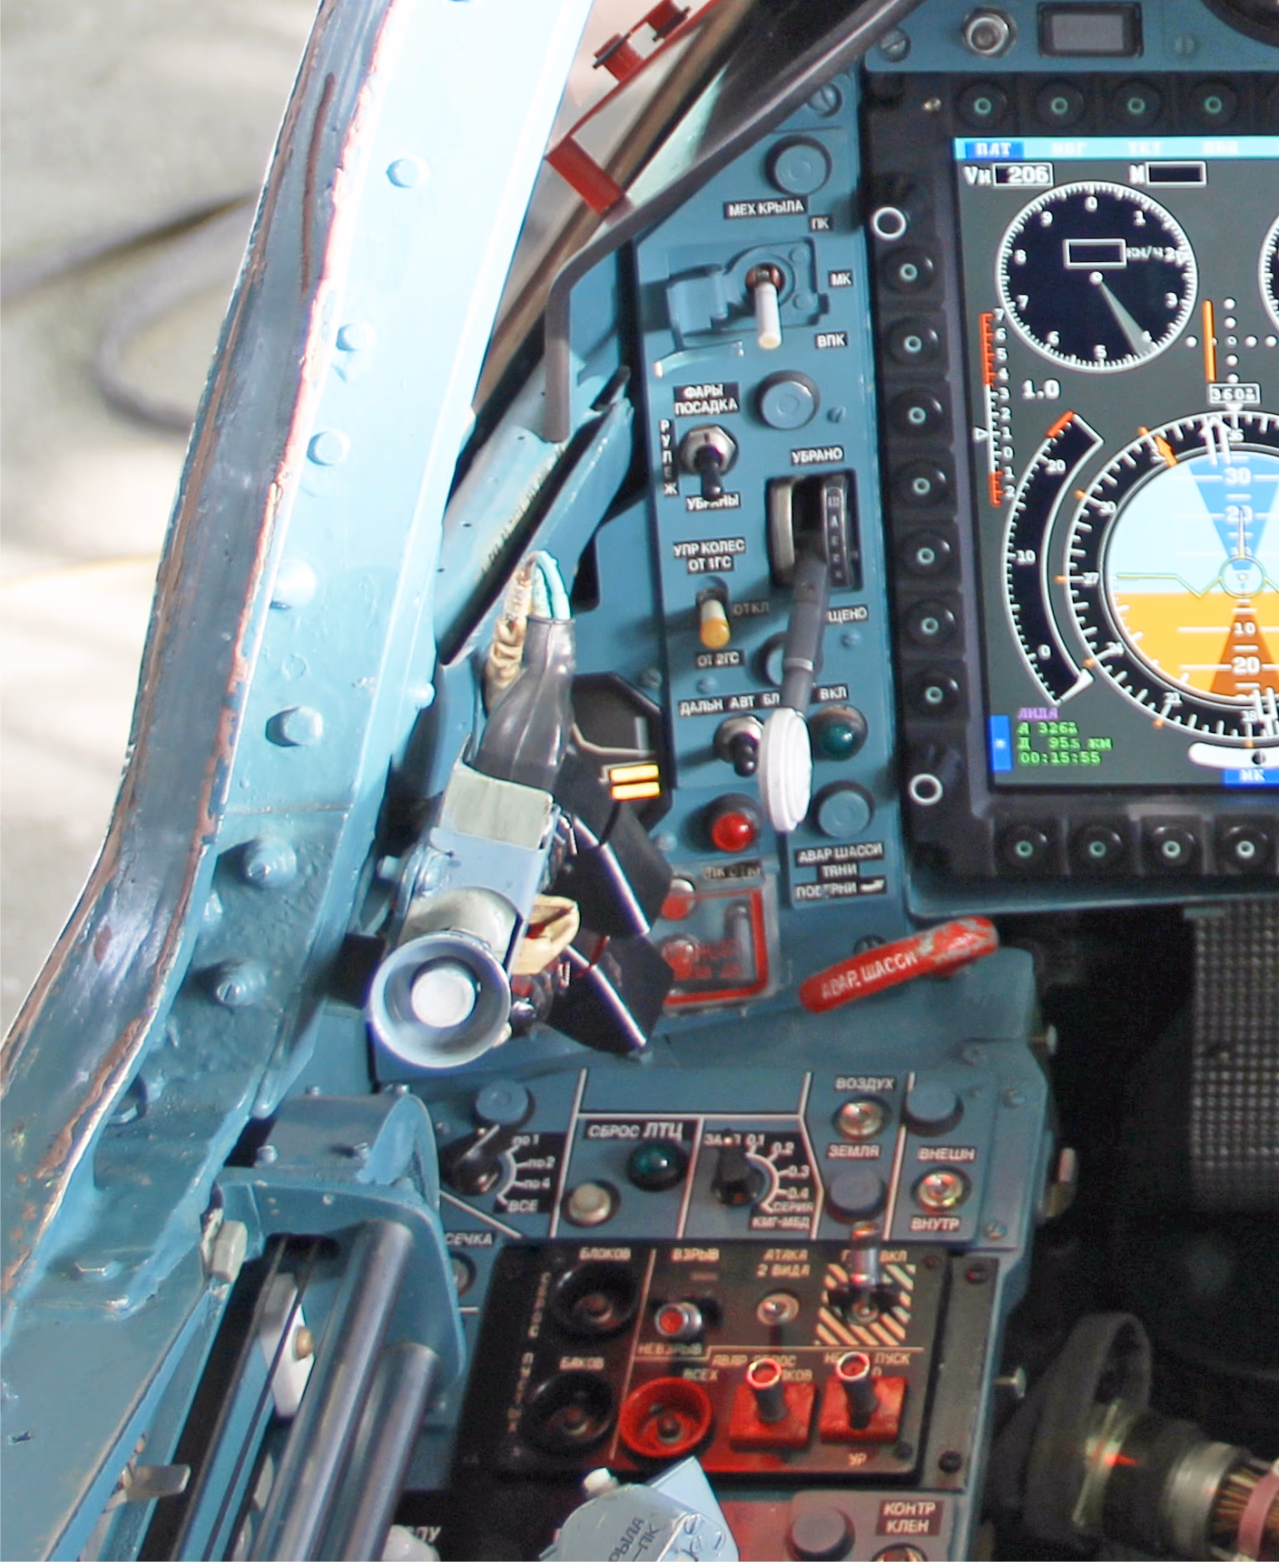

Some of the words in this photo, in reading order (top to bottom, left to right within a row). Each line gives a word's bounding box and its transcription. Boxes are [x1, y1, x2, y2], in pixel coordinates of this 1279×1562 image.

[1008, 167, 1049, 184] 206
[728, 203, 757, 217] МЕХ
[759, 200, 804, 214] КРЫЛА
[811, 216, 830, 230] ПК
[831, 272, 852, 286] МК
[816, 334, 845, 348] ВПК
[683, 385, 724, 399] ФАРЫ
[1022, 380, 1060, 400] 1.0
[674, 399, 738, 415] ПОСАДКА
[792, 447, 843, 465] УБРАНО
[1046, 459, 1066, 474] 20
[673, 542, 699, 557] УПР
[701, 538, 745, 555] КОЛЕС
[688, 558, 706, 571] ОТ
[708, 556, 732, 570] 1ГС
[1017, 549, 1036, 565] 10
[733, 602, 770, 615] ОТКЛ
[697, 653, 713, 666] ОТ
[715, 651, 740, 665] 2ГС
[1232, 658, 1260, 675] 20
[820, 687, 847, 701] ВКЛ
[681, 698, 724, 716] ДАЛЬН
[730, 695, 755, 709] АВТ
[1019, 751, 1102, 766] 00:15:55
[799, 848, 832, 863] АВАР
[834, 843, 882, 858] ШАССИ
[822, 864, 857, 877] ТЯНИ
[862, 950, 918, 983] ШАССИ
[835, 1076, 894, 1090] ВОЗДУХ
[588, 1124, 640, 1139] СБРОС
[643, 1121, 684, 1140] ЛТЦ
[746, 1134, 765, 1146] 0.1
[773, 1142, 794, 1155] 0.2
[829, 1144, 880, 1159] ЗЕМЛЯ
[918, 1147, 975, 1162] ВНЕШН
[789, 1165, 810, 1178] 0.3
[787, 1187, 809, 1199] 0.4
[508, 1200, 537, 1212] ВСЕ
[911, 1217, 960, 1232] ВНУТР
[446, 1232, 493, 1246] СЕЧКА
[579, 1247, 631, 1260] БЛОКОВ
[673, 1248, 719, 1262] ВЗРЫВ
[764, 1249, 808, 1262] АТАКА
[880, 1250, 907, 1262] ВКЛ
[773, 1264, 811, 1278] ВИДА
[560, 1357, 604, 1370] БАКОВ
[874, 1352, 910, 1365] ПУСК
[848, 1453, 868, 1467] УР
[884, 1502, 936, 1516] КОНТР
[886, 1519, 930, 1533] КЛЕН
